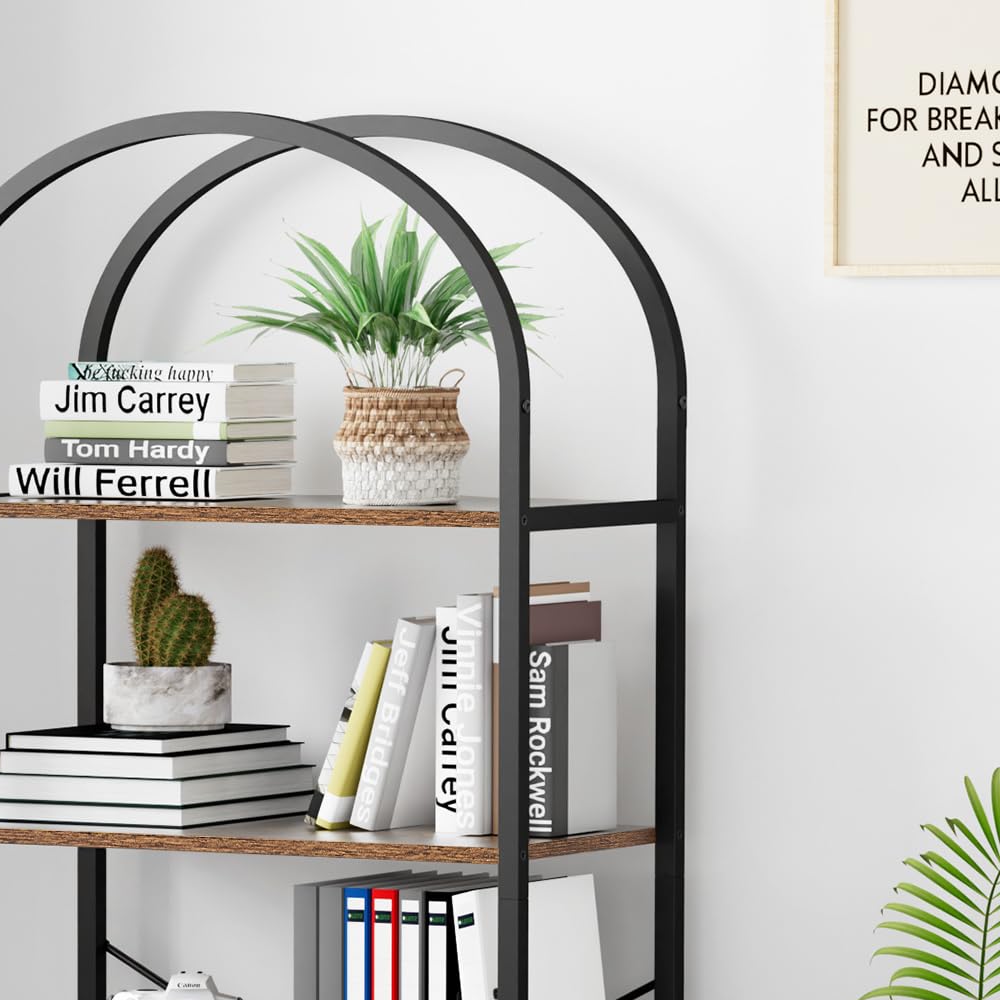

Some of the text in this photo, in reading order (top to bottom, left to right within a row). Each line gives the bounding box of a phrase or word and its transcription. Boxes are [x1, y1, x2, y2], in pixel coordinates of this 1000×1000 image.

[867, 107, 918, 132] FOR
[922, 141, 983, 168] AND
[167, 365, 215, 382] happy
[55, 384, 210, 422] Jim Carrey
[61, 439, 210, 465] Tom Hardy
[16, 467, 210, 498] Will Ferrell
[358, 627, 416, 823] Jeff Bridges
[458, 603, 483, 828] Vinnie Jones
[528, 651, 553, 833] Sam Rockwell
